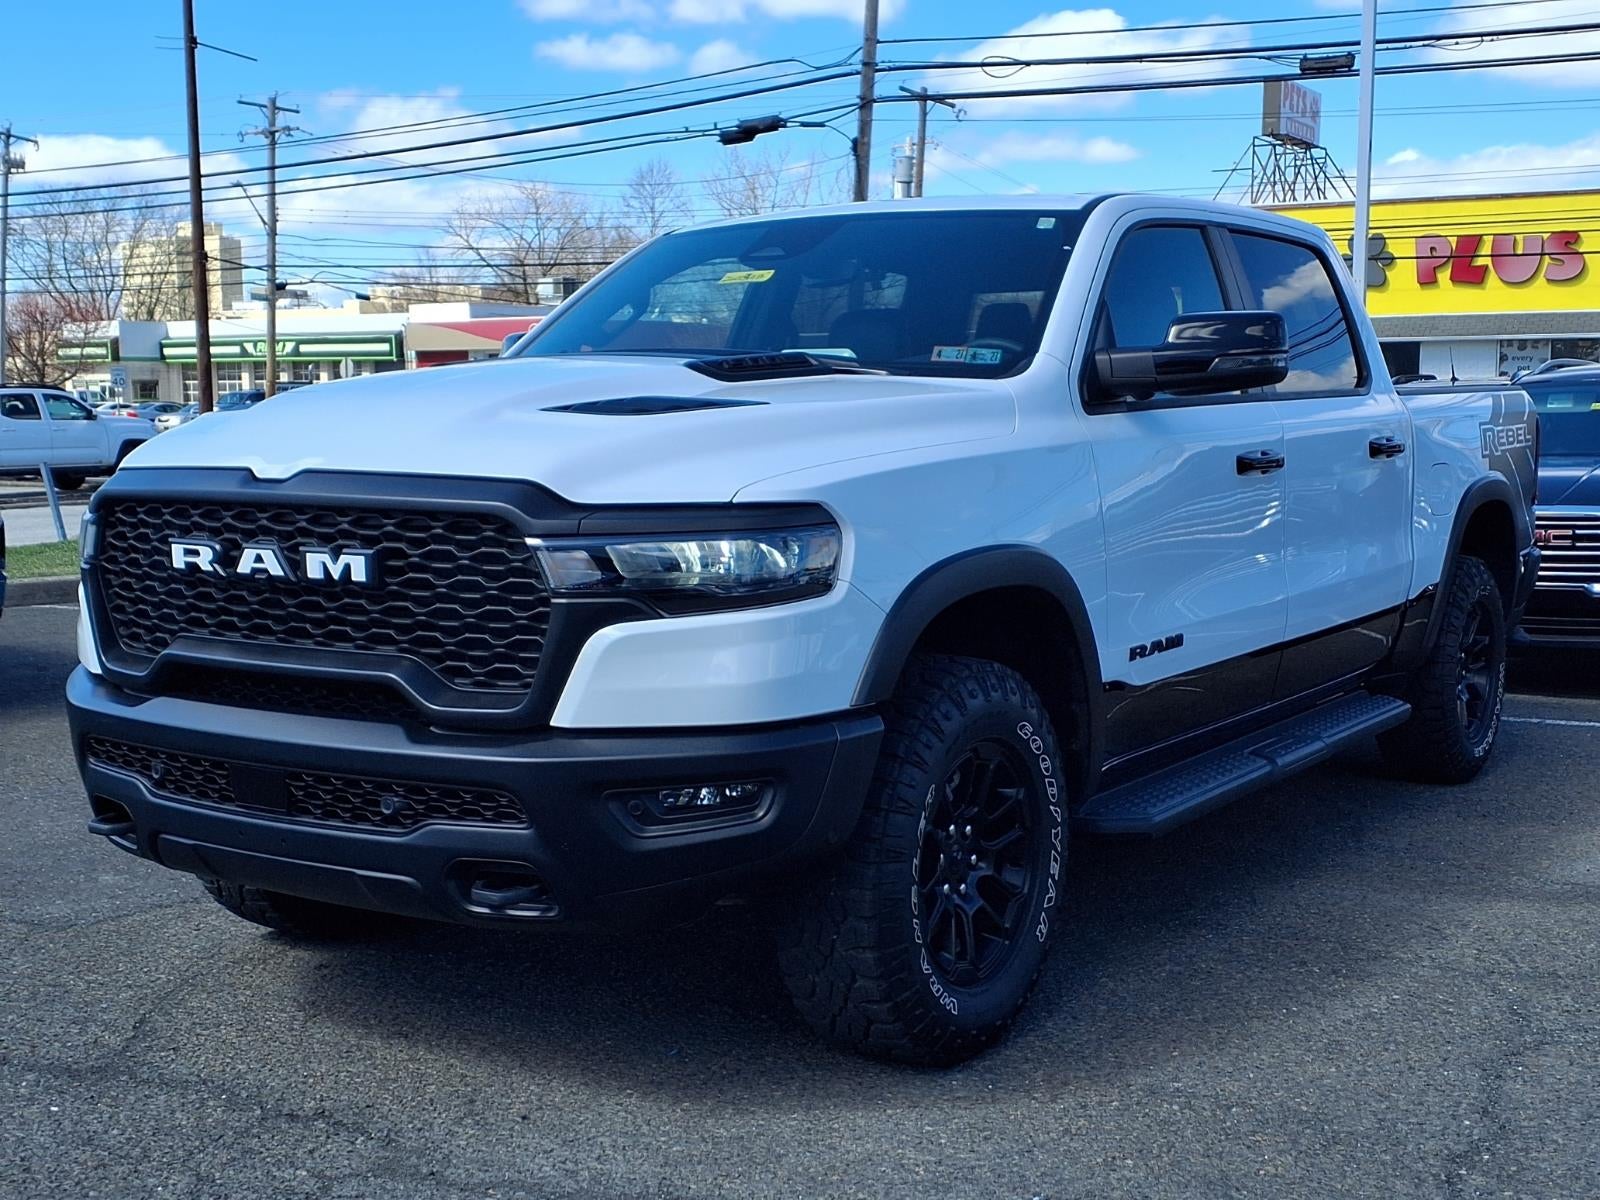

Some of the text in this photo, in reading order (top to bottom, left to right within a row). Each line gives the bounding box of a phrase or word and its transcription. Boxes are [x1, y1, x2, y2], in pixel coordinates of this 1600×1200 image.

[1415, 230, 1585, 285] PLUS
[112, 377, 125, 386] 40
[1480, 423, 1533, 456] REBEL
[169, 540, 371, 584] RAM
[1128, 632, 1184, 663] RAM
[1016, 721, 1062, 942] GOODYEAR
[911, 783, 958, 1015] WRANGLER
